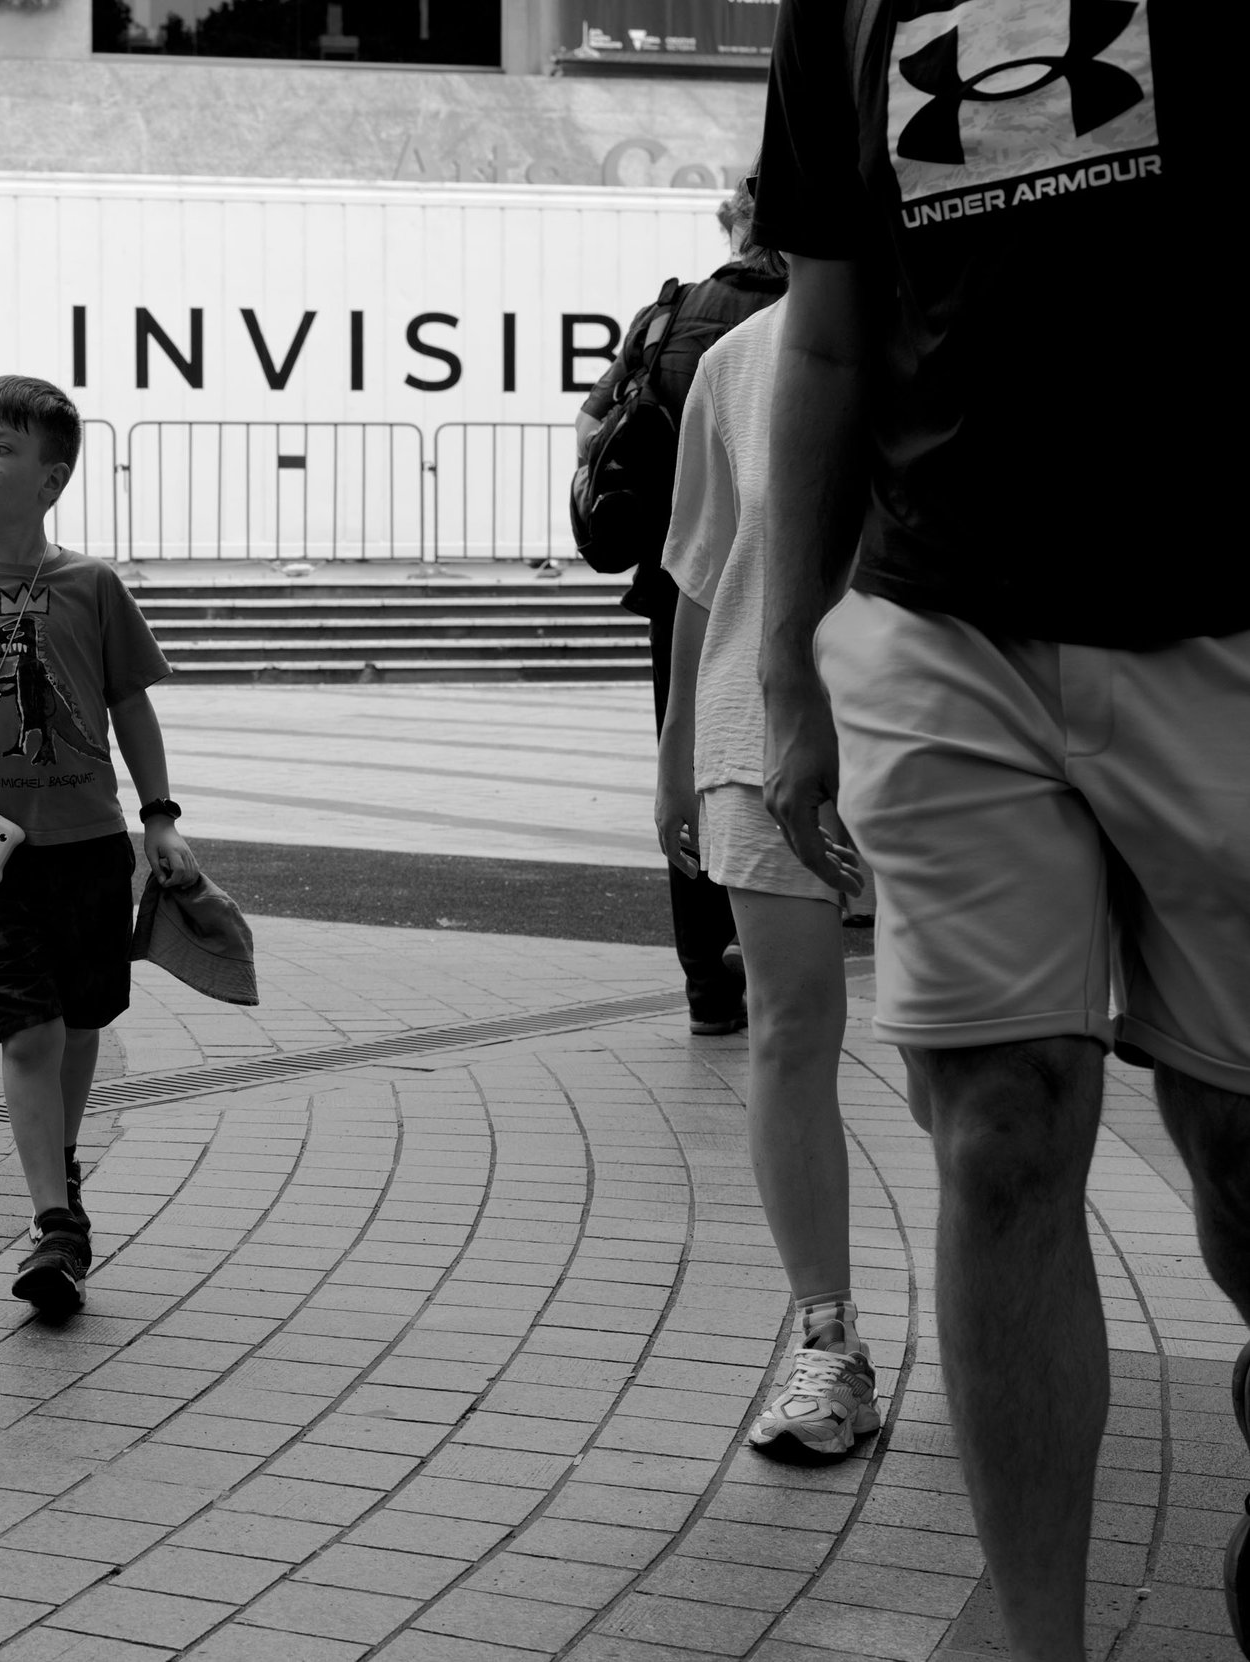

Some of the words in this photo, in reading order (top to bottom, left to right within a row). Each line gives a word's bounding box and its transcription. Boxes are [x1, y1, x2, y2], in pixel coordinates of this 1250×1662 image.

[392, 133, 564, 186] Arts
[902, 188, 1006, 228] UNDER
[1012, 154, 1163, 207] ARMOUR
[72, 305, 623, 392] INVISIB
